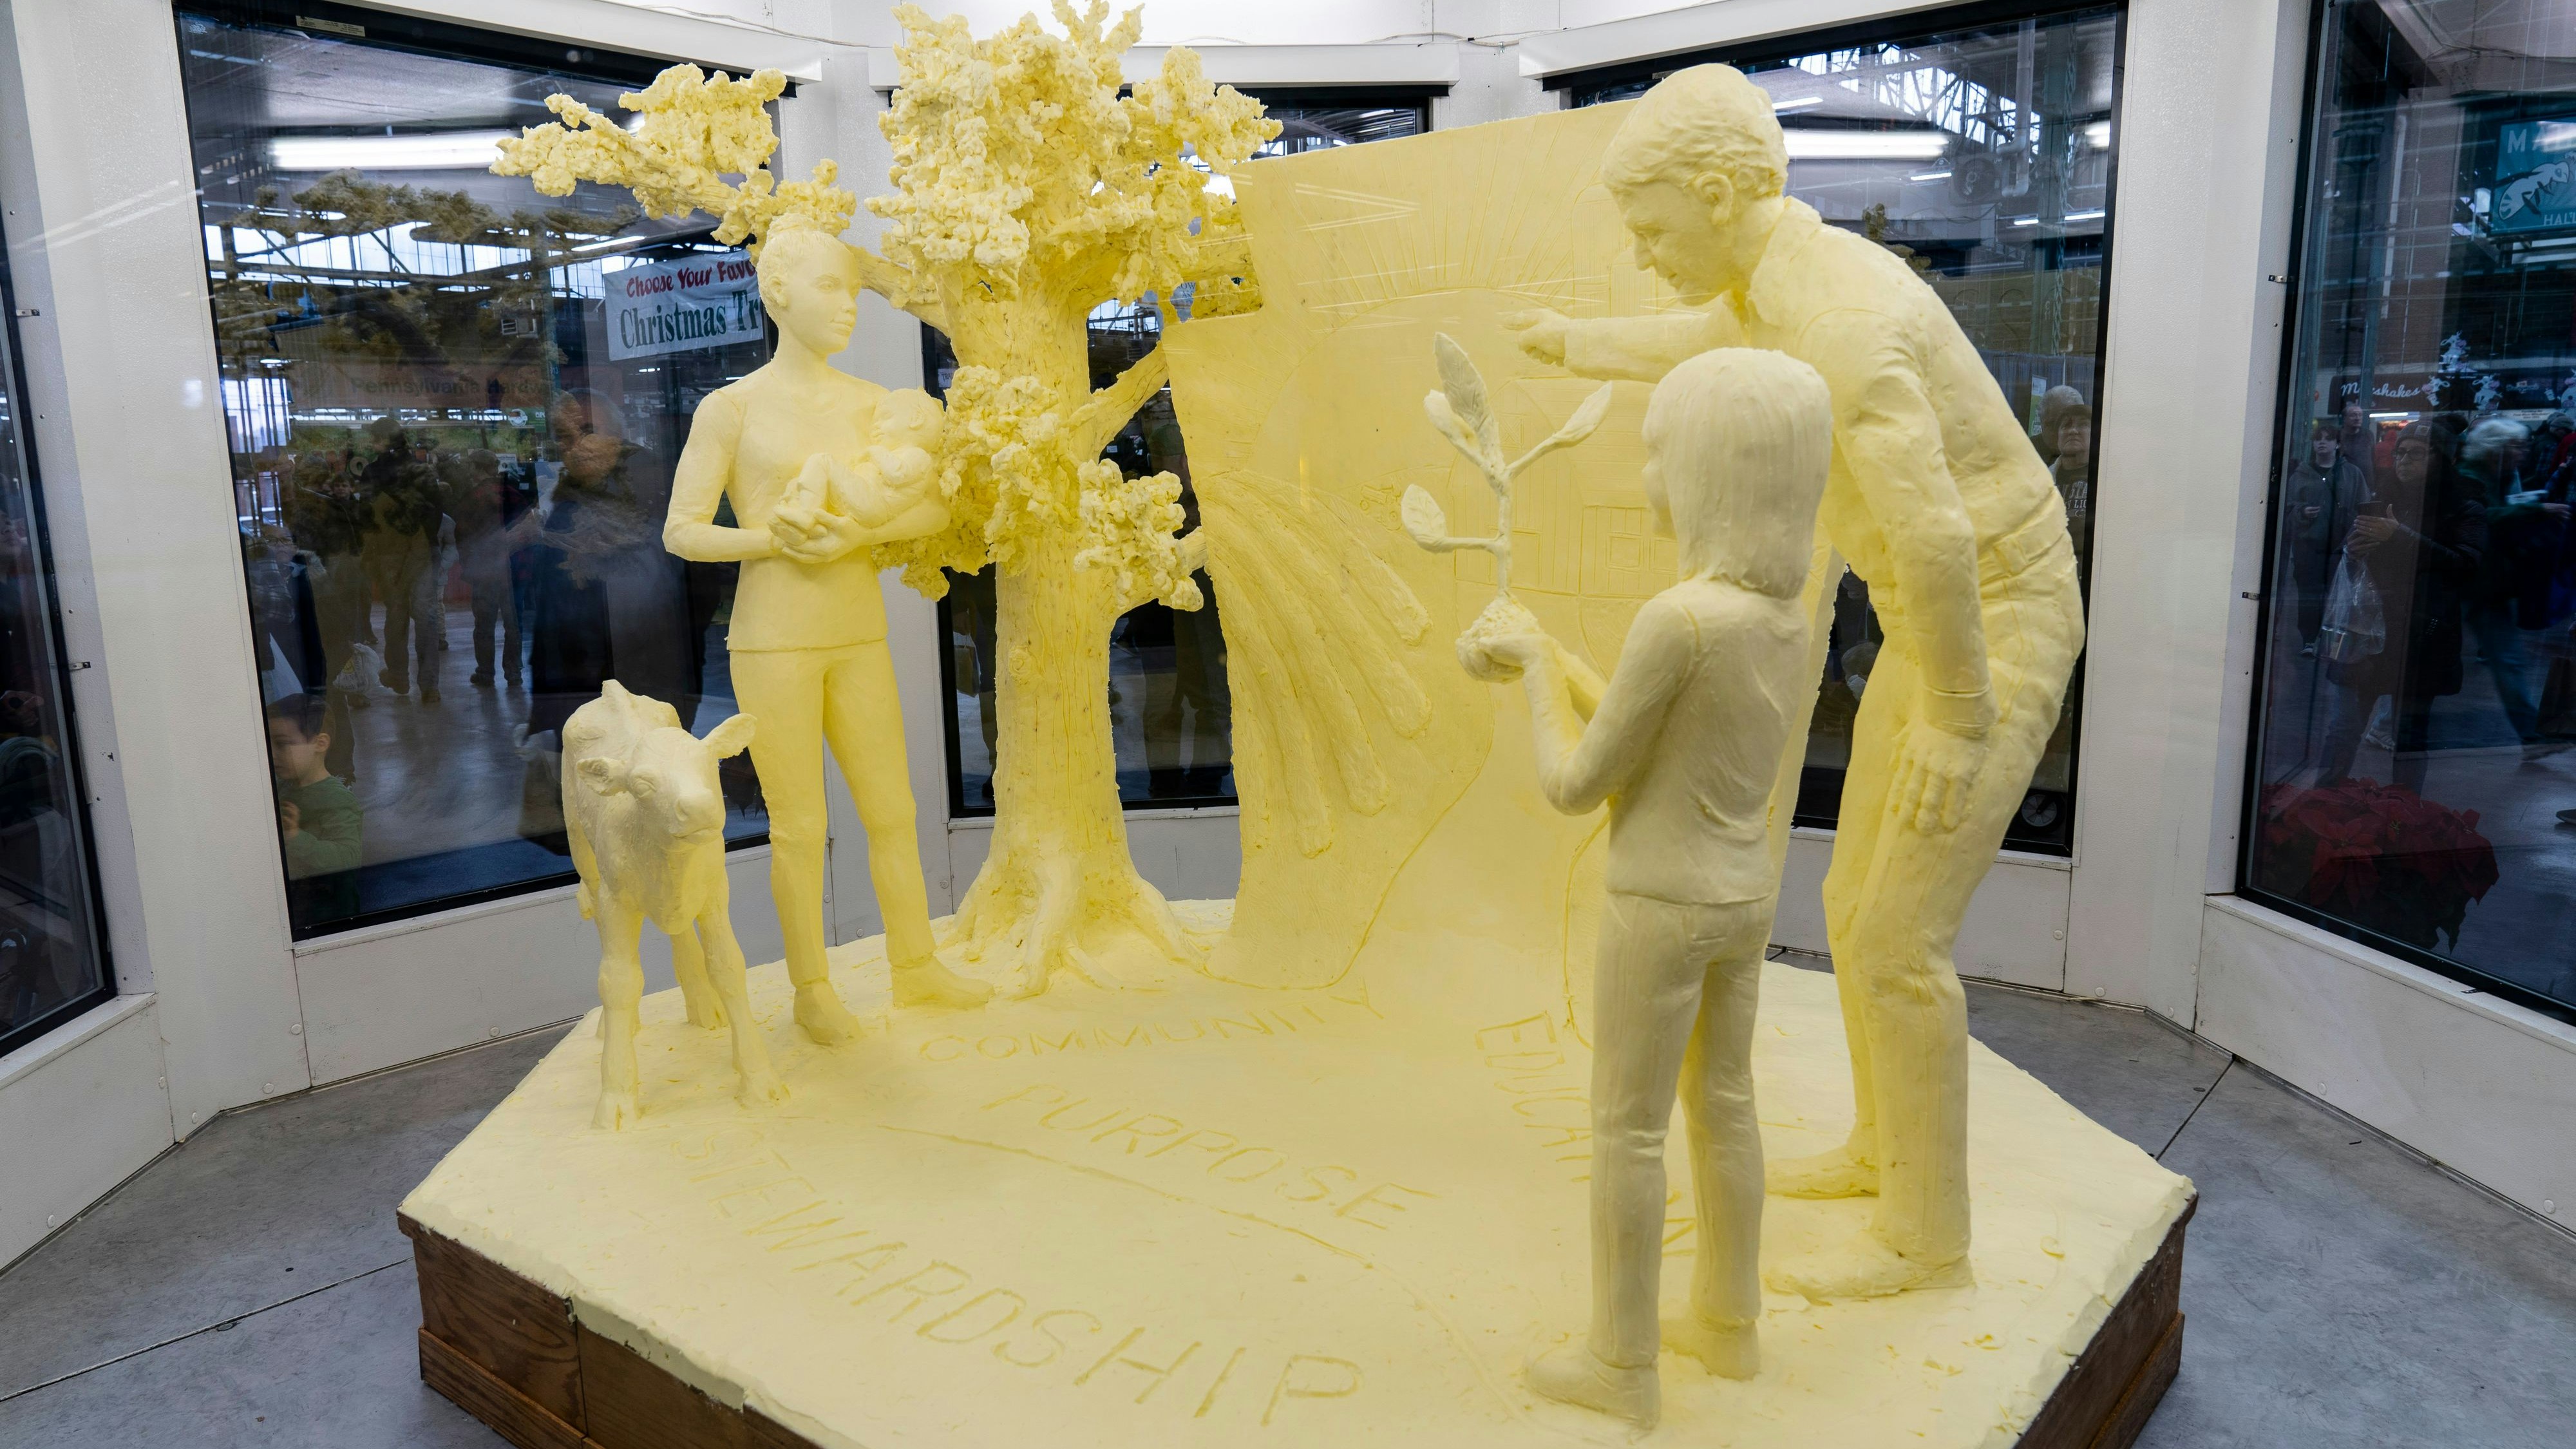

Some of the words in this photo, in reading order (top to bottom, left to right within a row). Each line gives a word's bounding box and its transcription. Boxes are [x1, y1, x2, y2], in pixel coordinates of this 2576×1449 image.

[627, 274, 674, 298] Choose
[677, 267, 712, 289] Your
[620, 301, 727, 349] Christmas
[732, 289, 759, 331] Tr
[351, 375, 480, 397] Pennsylvania
[2340, 382, 2421, 397] Mshakes
[919, 984, 1385, 1061] COMMUNITY
[979, 1083, 1444, 1231] PURPOSE
[670, 1127, 1365, 1427] STEWARDSHIP
